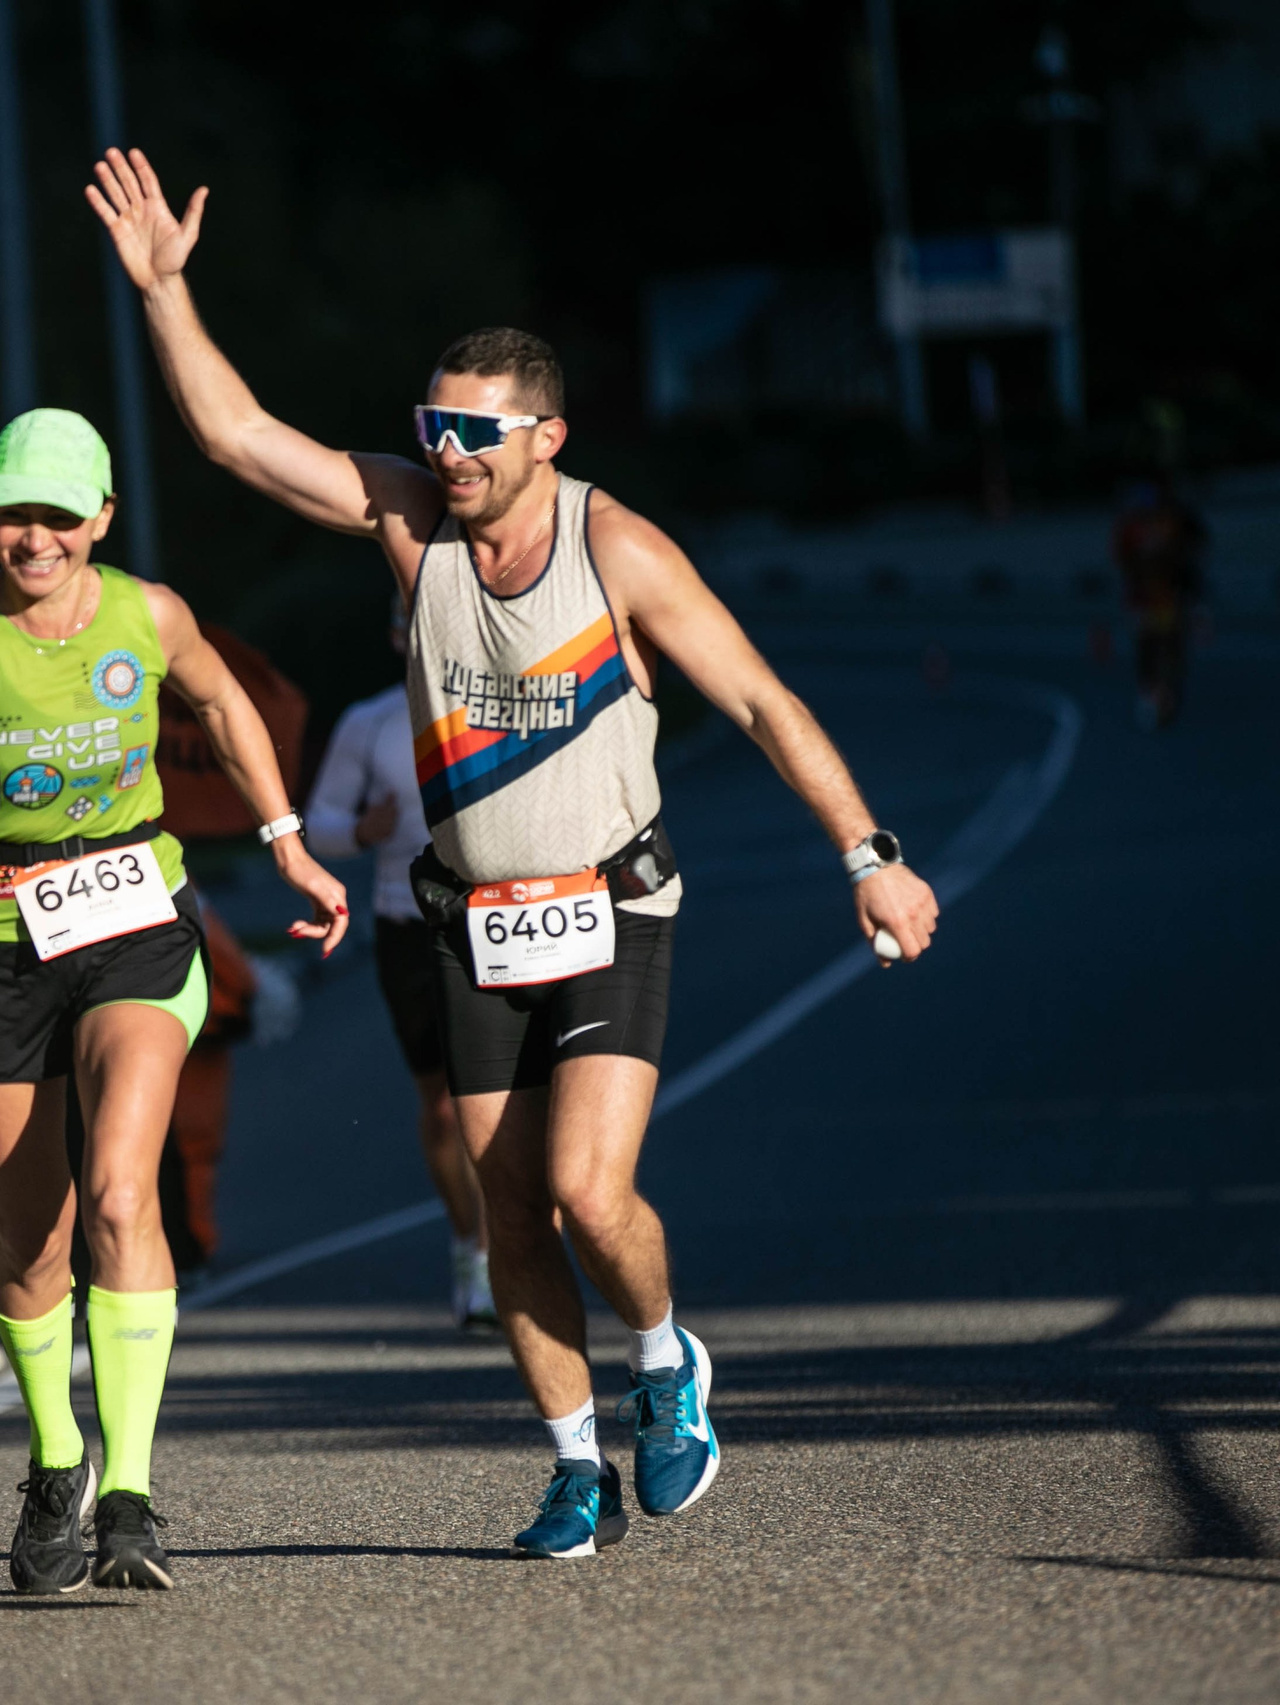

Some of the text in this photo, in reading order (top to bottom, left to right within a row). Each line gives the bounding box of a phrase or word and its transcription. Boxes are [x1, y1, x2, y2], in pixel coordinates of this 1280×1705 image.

[27, 733, 120, 760] GIVE
[68, 749, 123, 770] UP
[35, 854, 145, 912] 6463
[485, 899, 598, 945] 6405
[526, 943, 558, 955] ЮРИЙ
